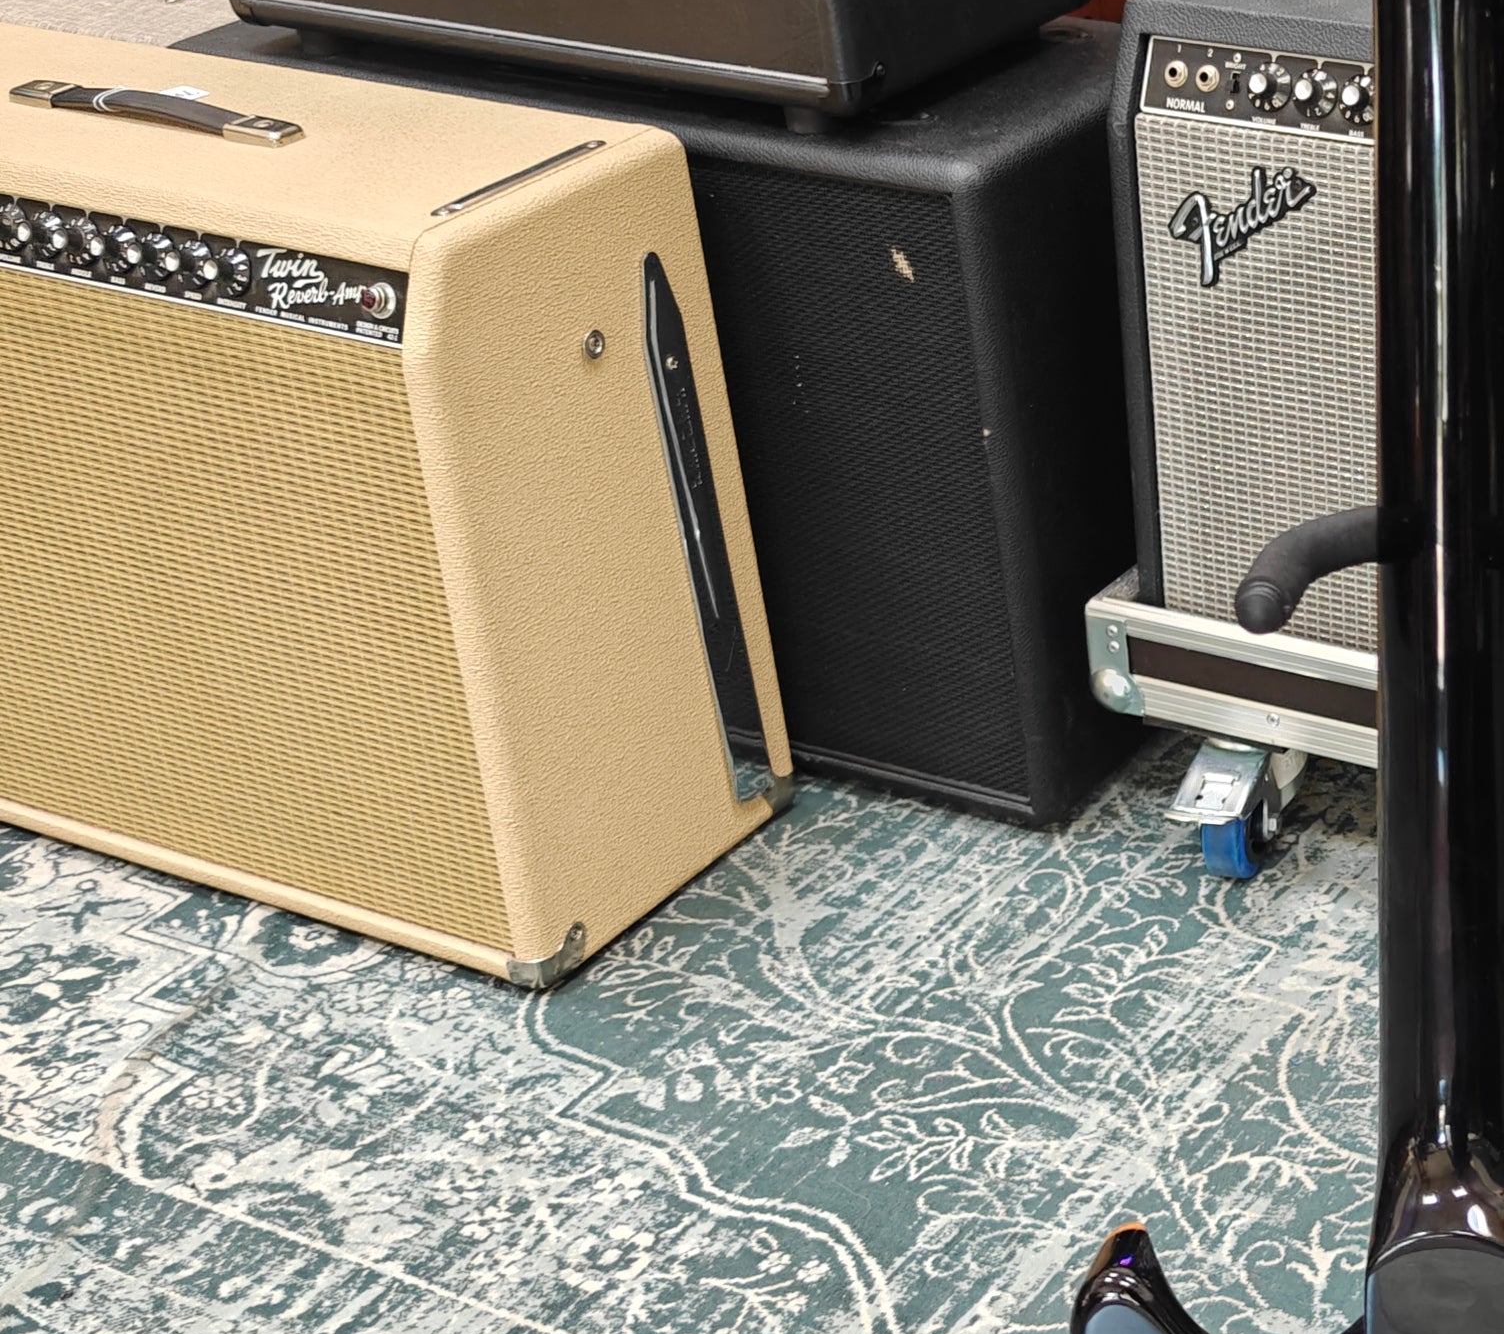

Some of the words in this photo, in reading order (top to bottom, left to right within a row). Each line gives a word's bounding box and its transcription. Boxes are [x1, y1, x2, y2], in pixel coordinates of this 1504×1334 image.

[1166, 96, 1206, 114] NORMAL
[1173, 168, 1312, 286] Fender
[256, 248, 325, 288] Twin
[255, 306, 278, 317] FENDER
[280, 310, 305, 322] MUSICAL
[308, 316, 349, 331] INSTRUMENTS
